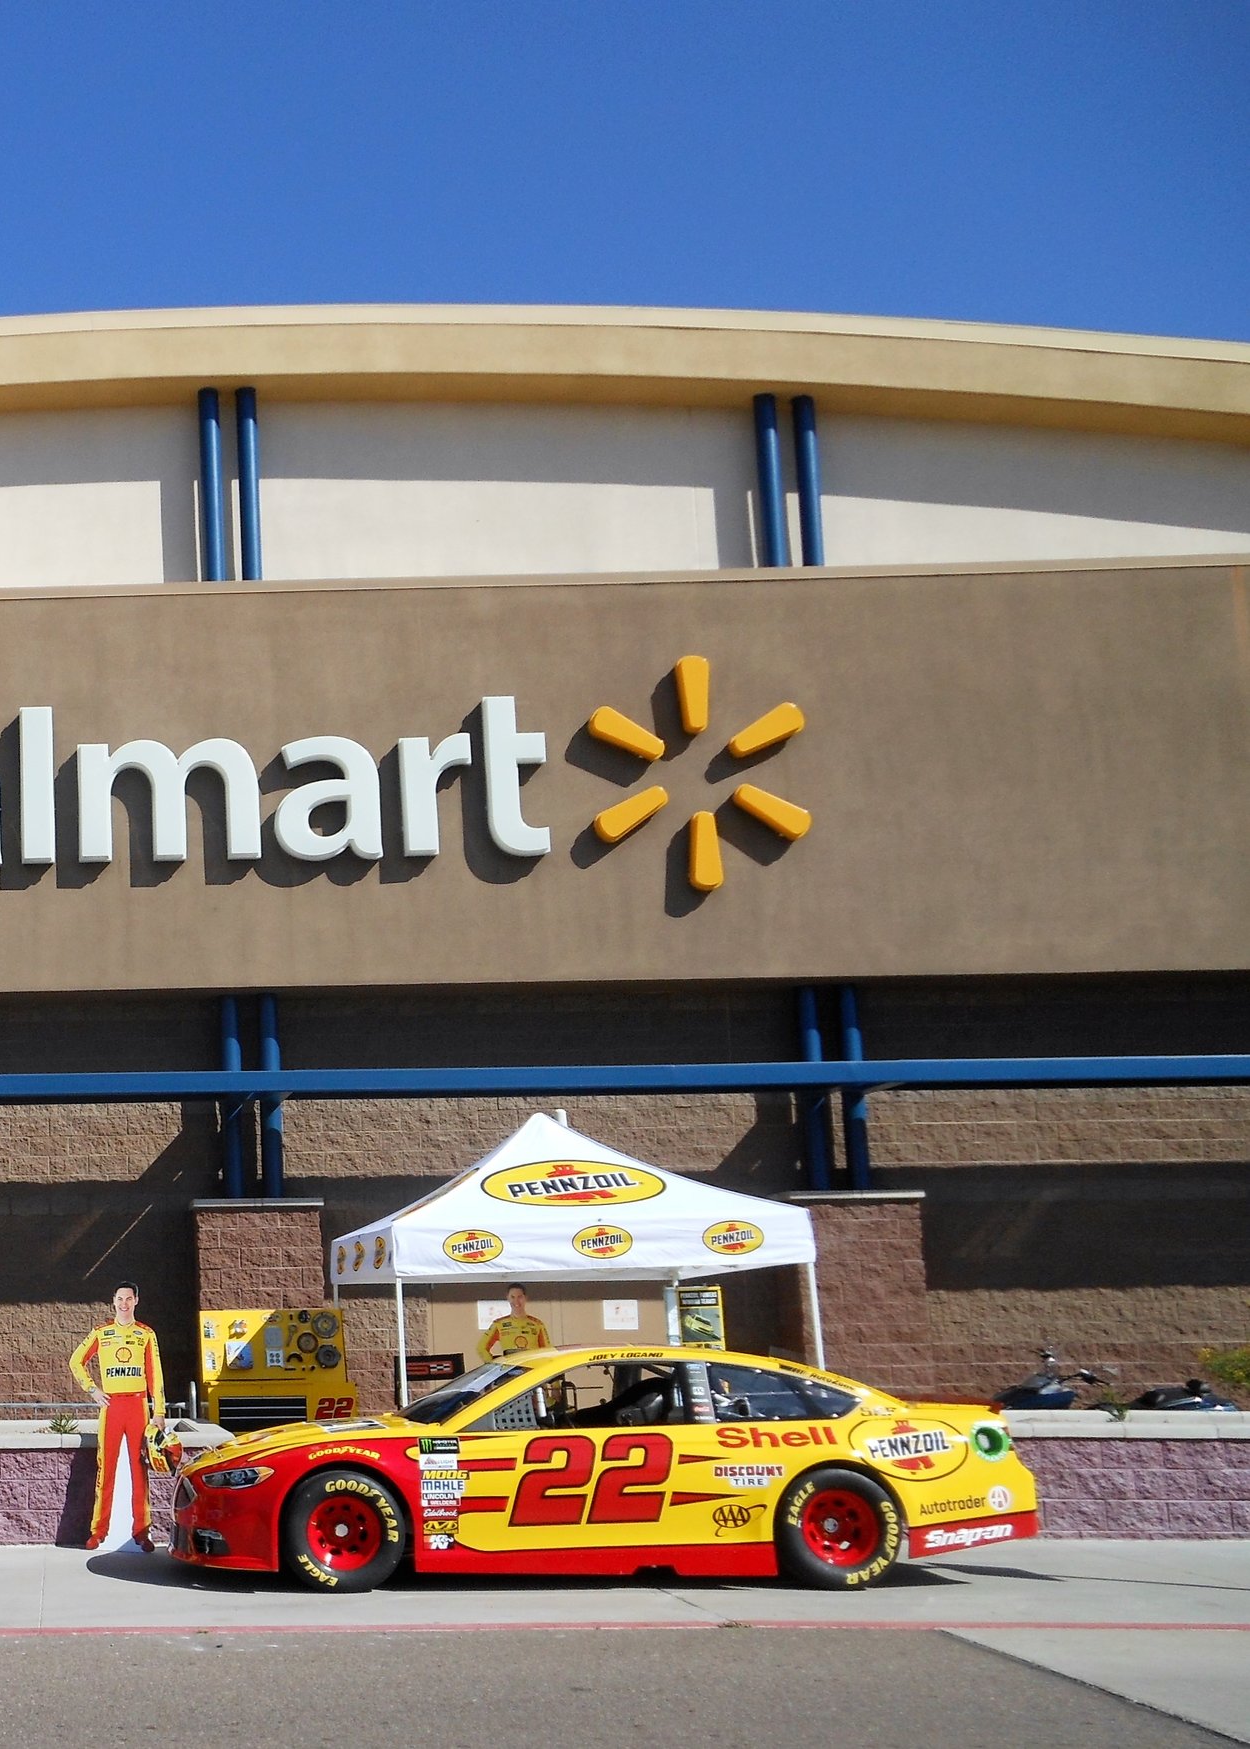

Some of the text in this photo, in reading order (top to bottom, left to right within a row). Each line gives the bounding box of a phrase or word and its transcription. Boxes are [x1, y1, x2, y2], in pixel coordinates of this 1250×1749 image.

[507, 1172, 637, 1198] PENNZOIL
[581, 1234, 623, 1250] PENNZOIL
[711, 1229, 755, 1246] PENNZOIL
[451, 1238, 495, 1255] PENNZOIL
[588, 1353, 618, 1361] JOEY
[106, 1367, 143, 1378] PENNZOIL
[314, 1397, 355, 1421] 22
[860, 1407, 896, 1417] SF
[715, 1426, 838, 1449] Shell
[423, 1471, 468, 1479] MOOG
[507, 1432, 674, 1527] 22
[714, 1465, 783, 1477] DISCOUNT
[423, 1481, 463, 1490] MAHLE
[733, 1478, 764, 1486] TIRE
[786, 1481, 816, 1527] EAGLE
[919, 1494, 987, 1517] Autotrader
[423, 1509, 457, 1517] Edelbrock
[717, 1505, 748, 1527] AAA
[924, 1523, 1014, 1548] Snap-on
[296, 1553, 339, 1588] EAGLE
